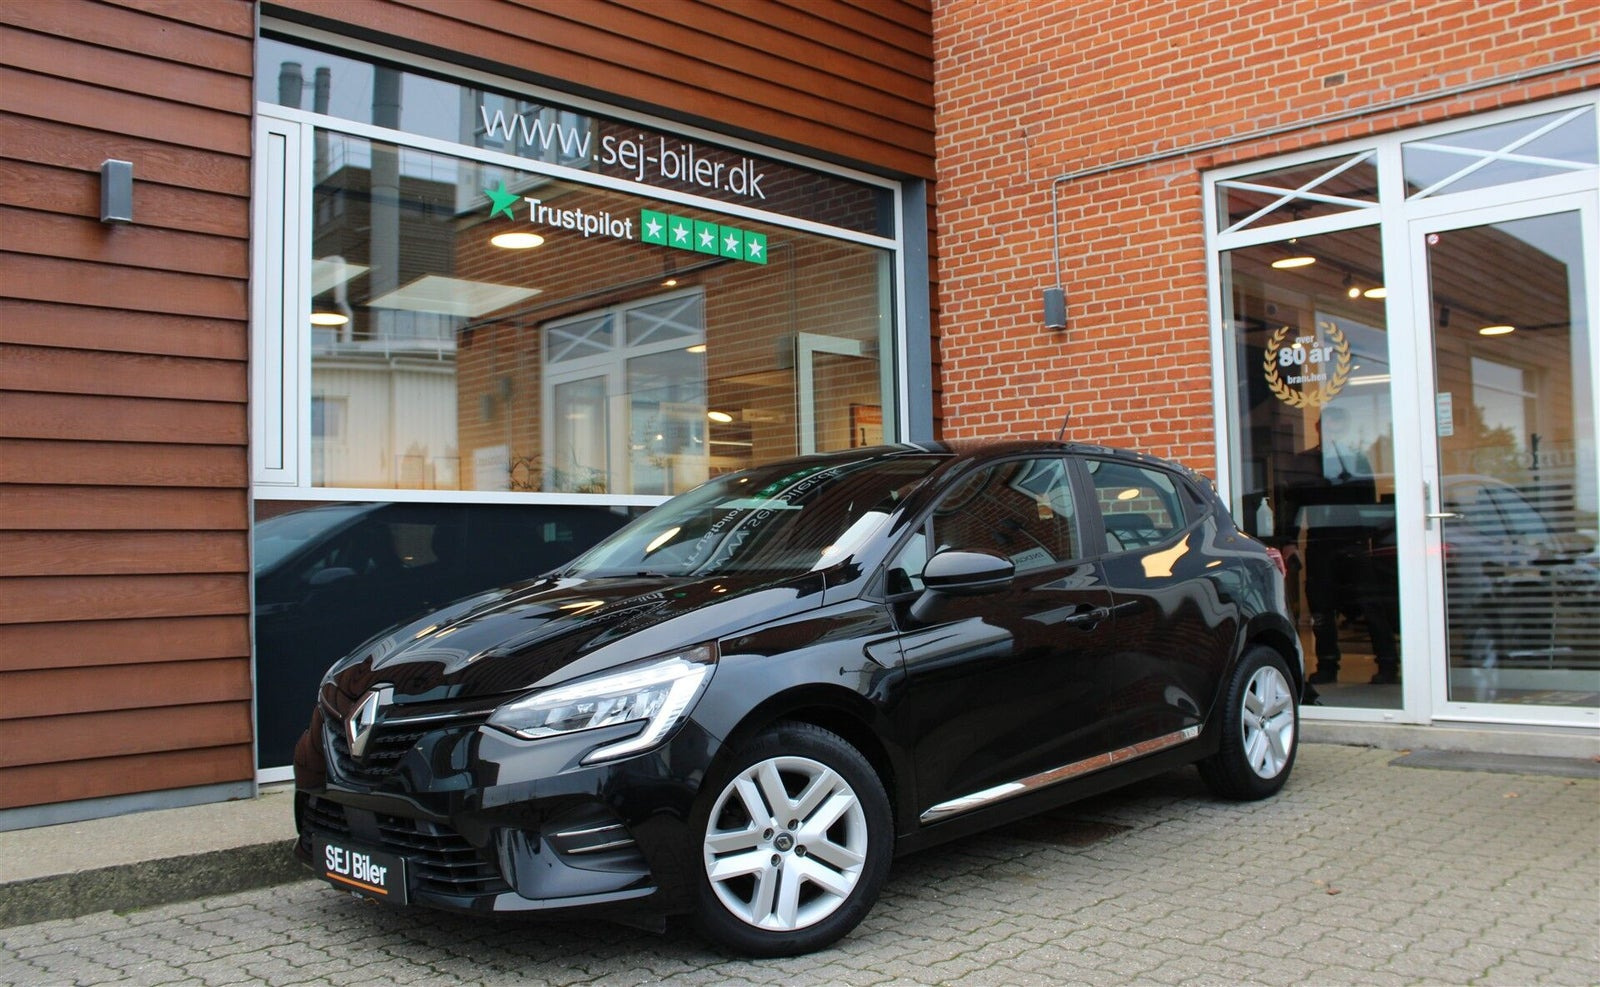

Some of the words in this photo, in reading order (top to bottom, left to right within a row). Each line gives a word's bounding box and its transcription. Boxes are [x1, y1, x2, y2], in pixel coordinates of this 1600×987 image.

[480, 105, 766, 199] www.sej-biler.dk
[524, 197, 633, 240] Trustpilot
[1279, 347, 1306, 366] 80
[1309, 342, 1333, 363] år
[1295, 336, 1315, 344] over
[325, 844, 350, 875] SEJ
[352, 851, 387, 886] Biler
